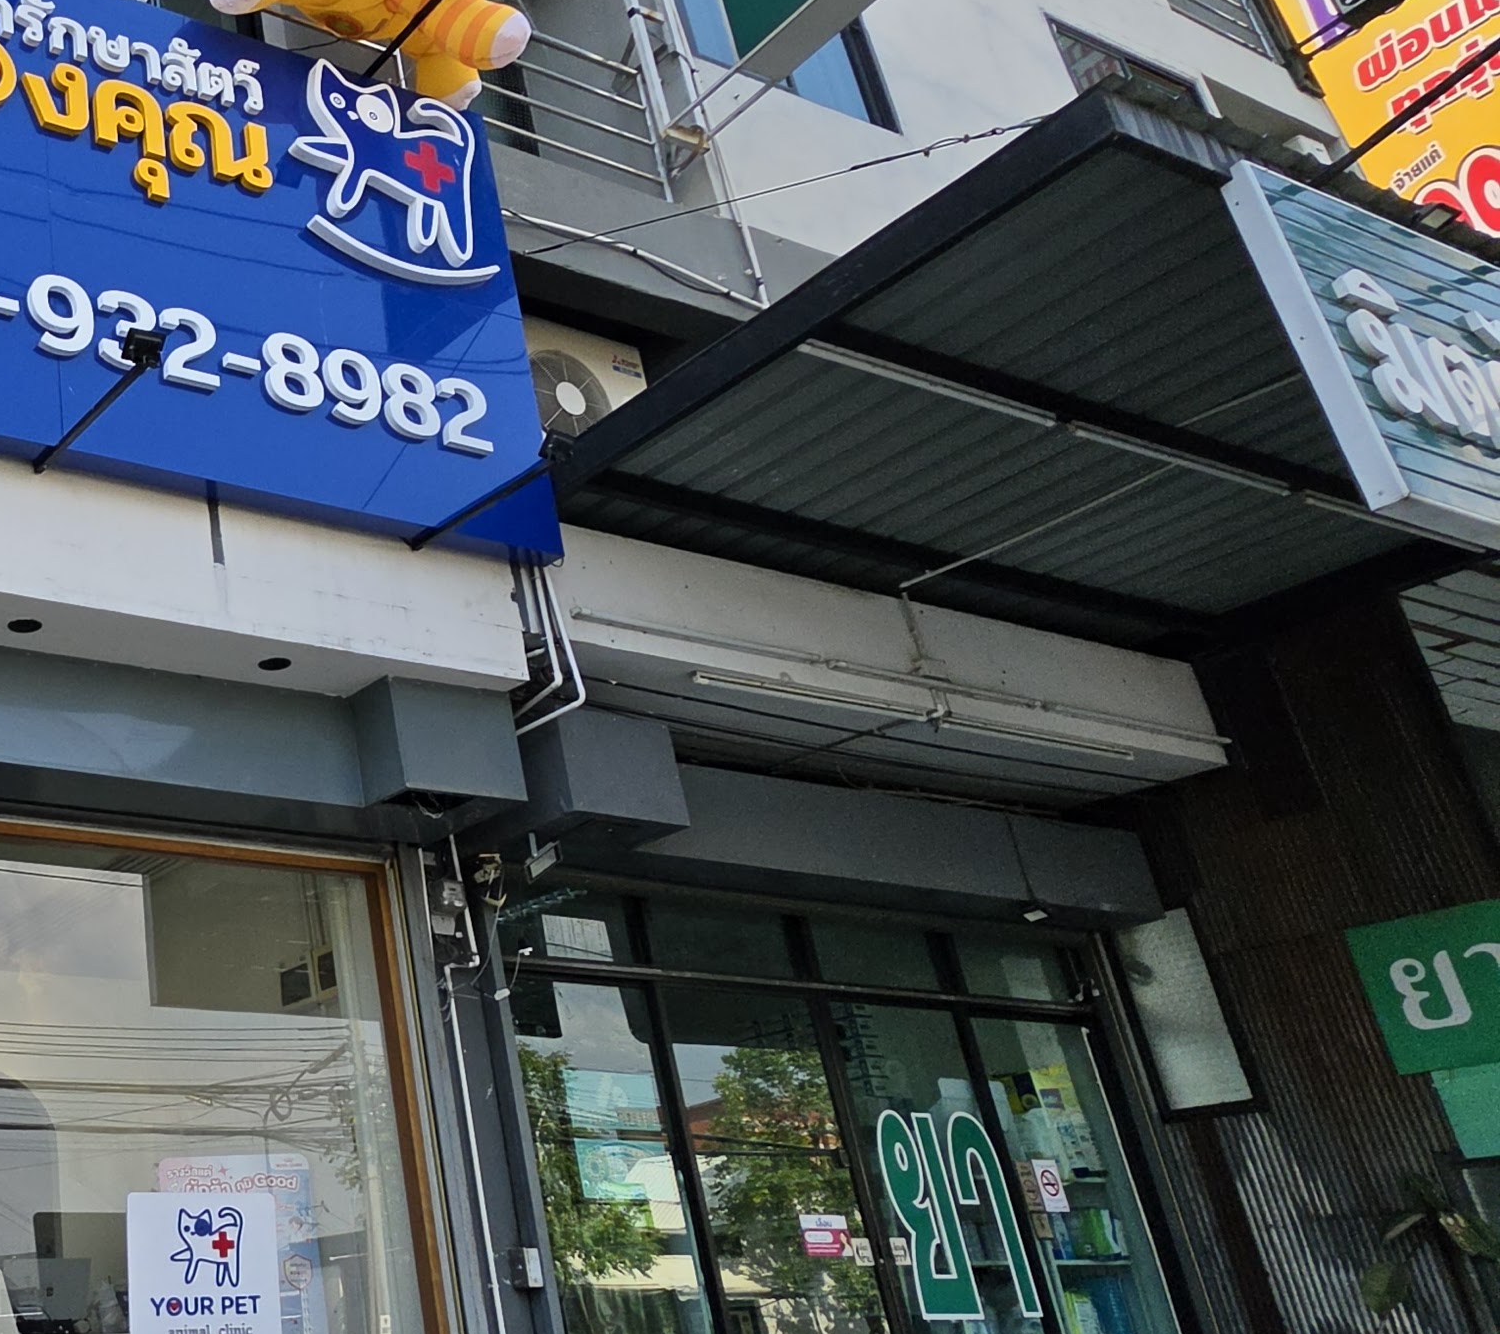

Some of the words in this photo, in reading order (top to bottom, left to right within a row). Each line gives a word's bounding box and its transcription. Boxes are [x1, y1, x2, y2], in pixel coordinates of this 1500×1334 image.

[1331, 267, 1500, 452] มิต
[253, 1173, 298, 1191] Good
[876, 1109, 1043, 1321] ยา
[150, 1296, 214, 1317] YOUR
[221, 1295, 261, 1315] PET
